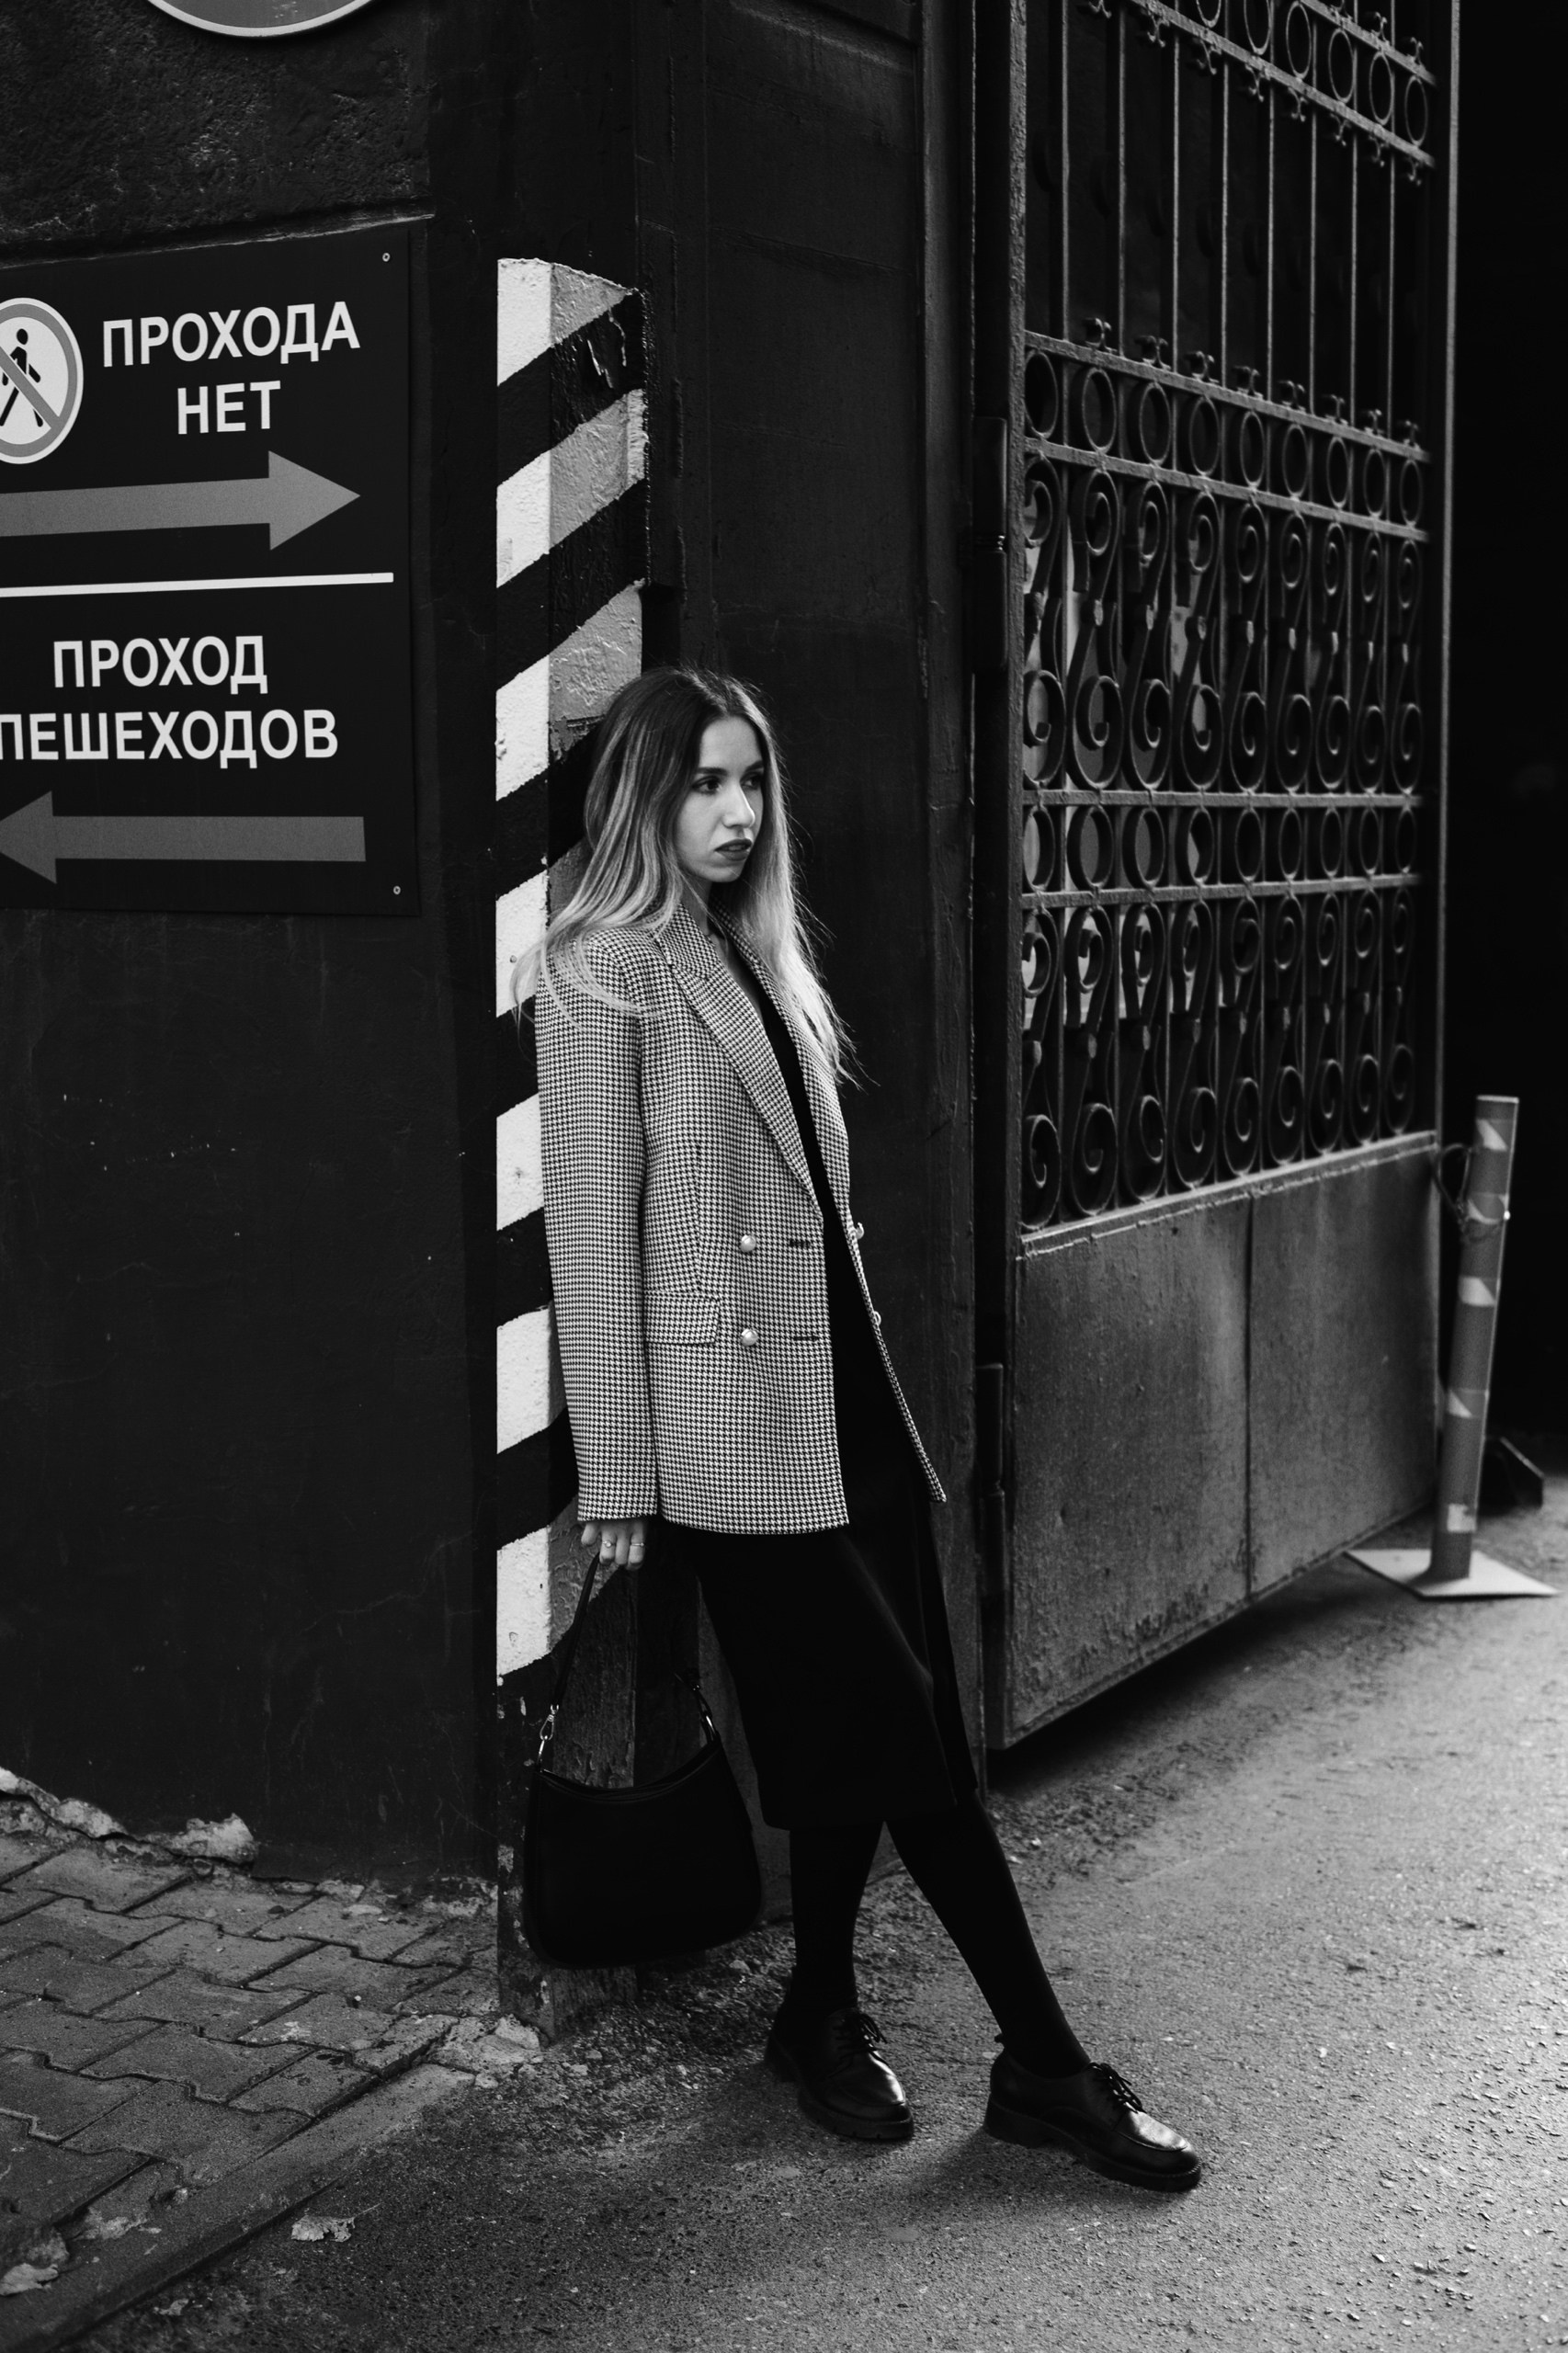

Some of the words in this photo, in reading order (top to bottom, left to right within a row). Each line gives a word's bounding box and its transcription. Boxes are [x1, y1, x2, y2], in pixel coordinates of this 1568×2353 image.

[103, 301, 361, 368] ПРОХОДА
[177, 380, 281, 435] НЕТ
[53, 635, 268, 695] ПРОХОД
[0, 709, 338, 769] ПЕШЕХОДОВ
